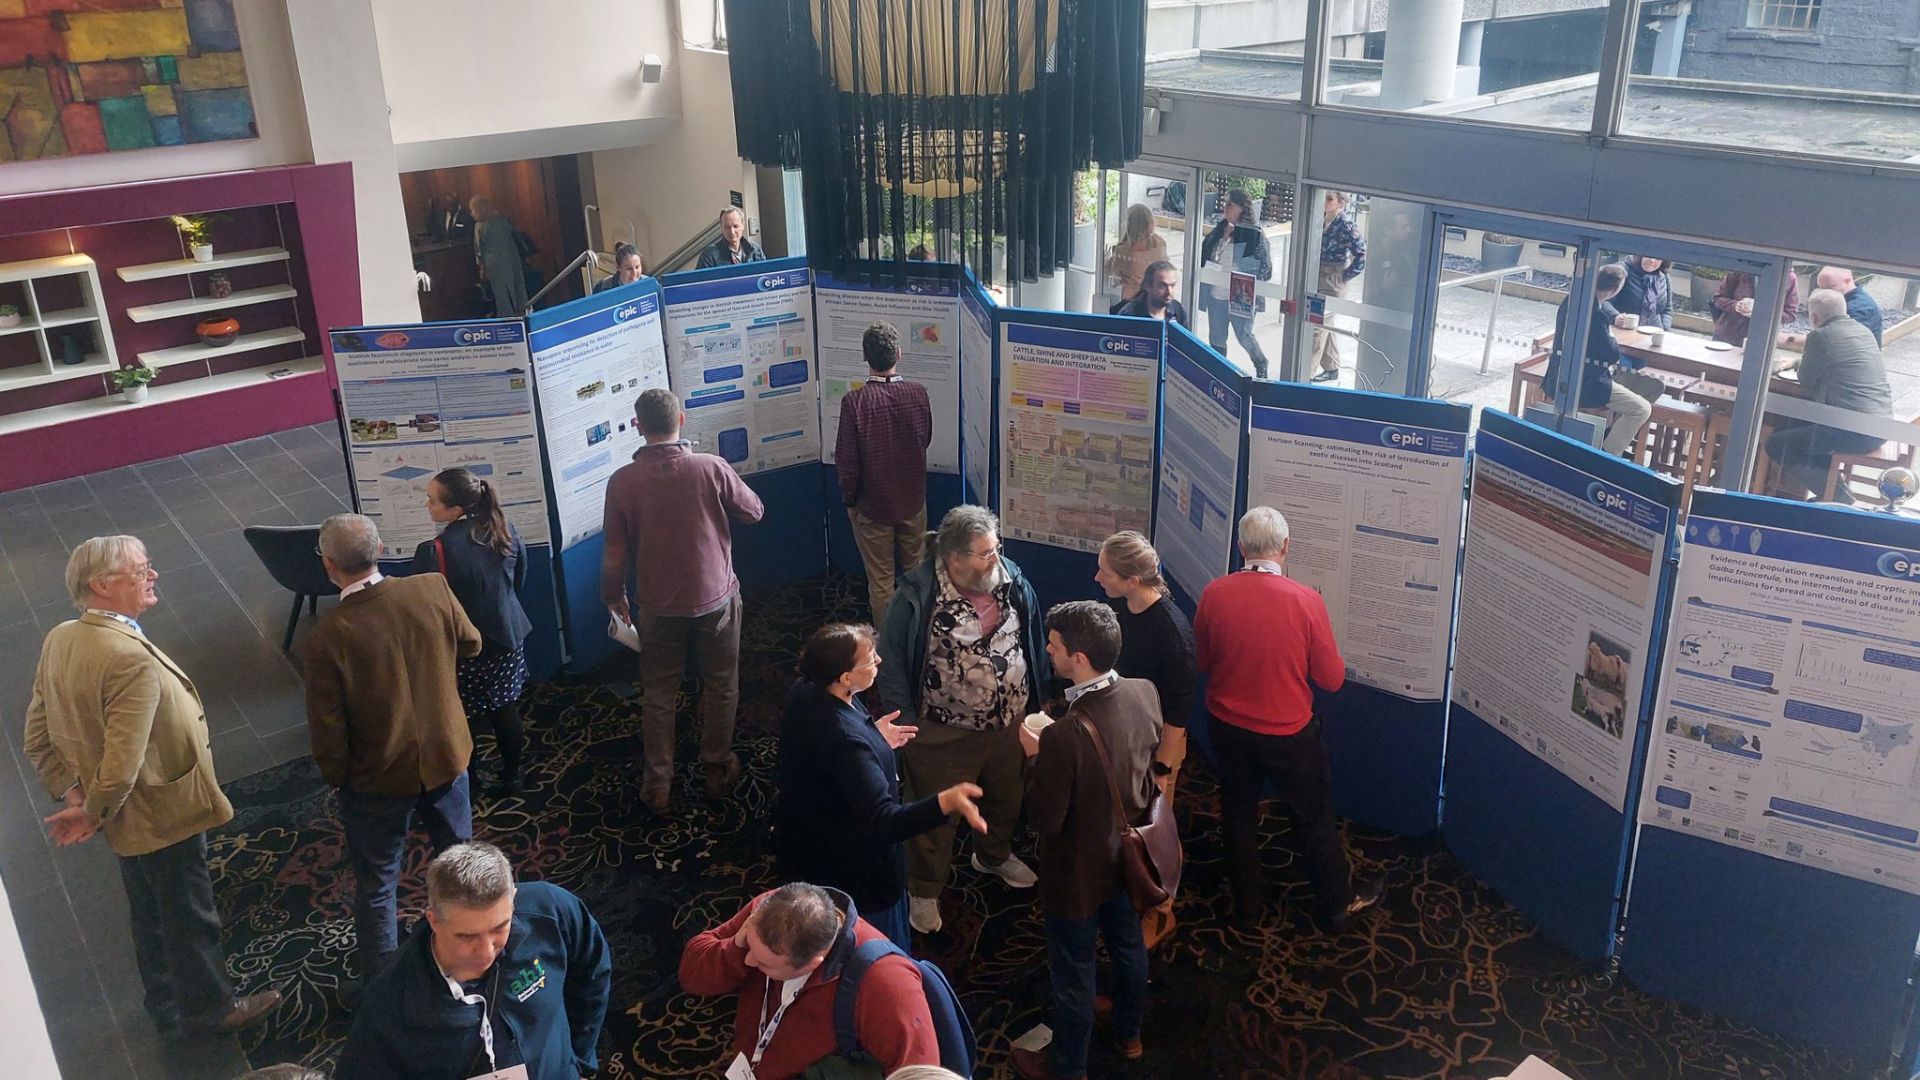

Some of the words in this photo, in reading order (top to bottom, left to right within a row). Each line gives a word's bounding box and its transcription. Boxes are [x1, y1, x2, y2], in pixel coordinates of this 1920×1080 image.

[764, 276, 786, 288] epic
[620, 305, 637, 319] epic
[463, 329, 492, 342] epic
[1013, 346, 1036, 356] CATTLE,
[1036, 349, 1055, 357] SWINE
[1071, 353, 1089, 361] SHEEP
[1091, 355, 1106, 363] DATA
[1106, 340, 1130, 352] epic
[1013, 355, 1050, 365] EVALUATION
[1051, 358, 1064, 366] AND
[1066, 361, 1106, 372] INTEGRATION
[1391, 432, 1424, 446] epic
[1309, 451, 1328, 459] exotic
[1330, 453, 1357, 463] diseases
[1374, 460, 1403, 470] Scotland
[1326, 445, 1361, 456] estimating
[1397, 455, 1440, 467] introduction
[1597, 490, 1627, 511] epic
[1710, 554, 1747, 566] Evidence
[1760, 563, 1807, 577] population
[1809, 572, 1854, 585] expansion
[1856, 580, 1873, 588] and
[1876, 584, 1906, 594] cryptic
[1709, 564, 1734, 574] Galba
[1736, 569, 1782, 583] truncatula,
[1785, 577, 1799, 585] the
[1802, 581, 1858, 596] intermediate
[1860, 591, 1880, 599] host
[1894, 597, 1910, 605] the
[1775, 586, 1805, 596] spread
[1807, 591, 1823, 599] and
[1825, 594, 1857, 606] control
[1870, 603, 1904, 614] disease
